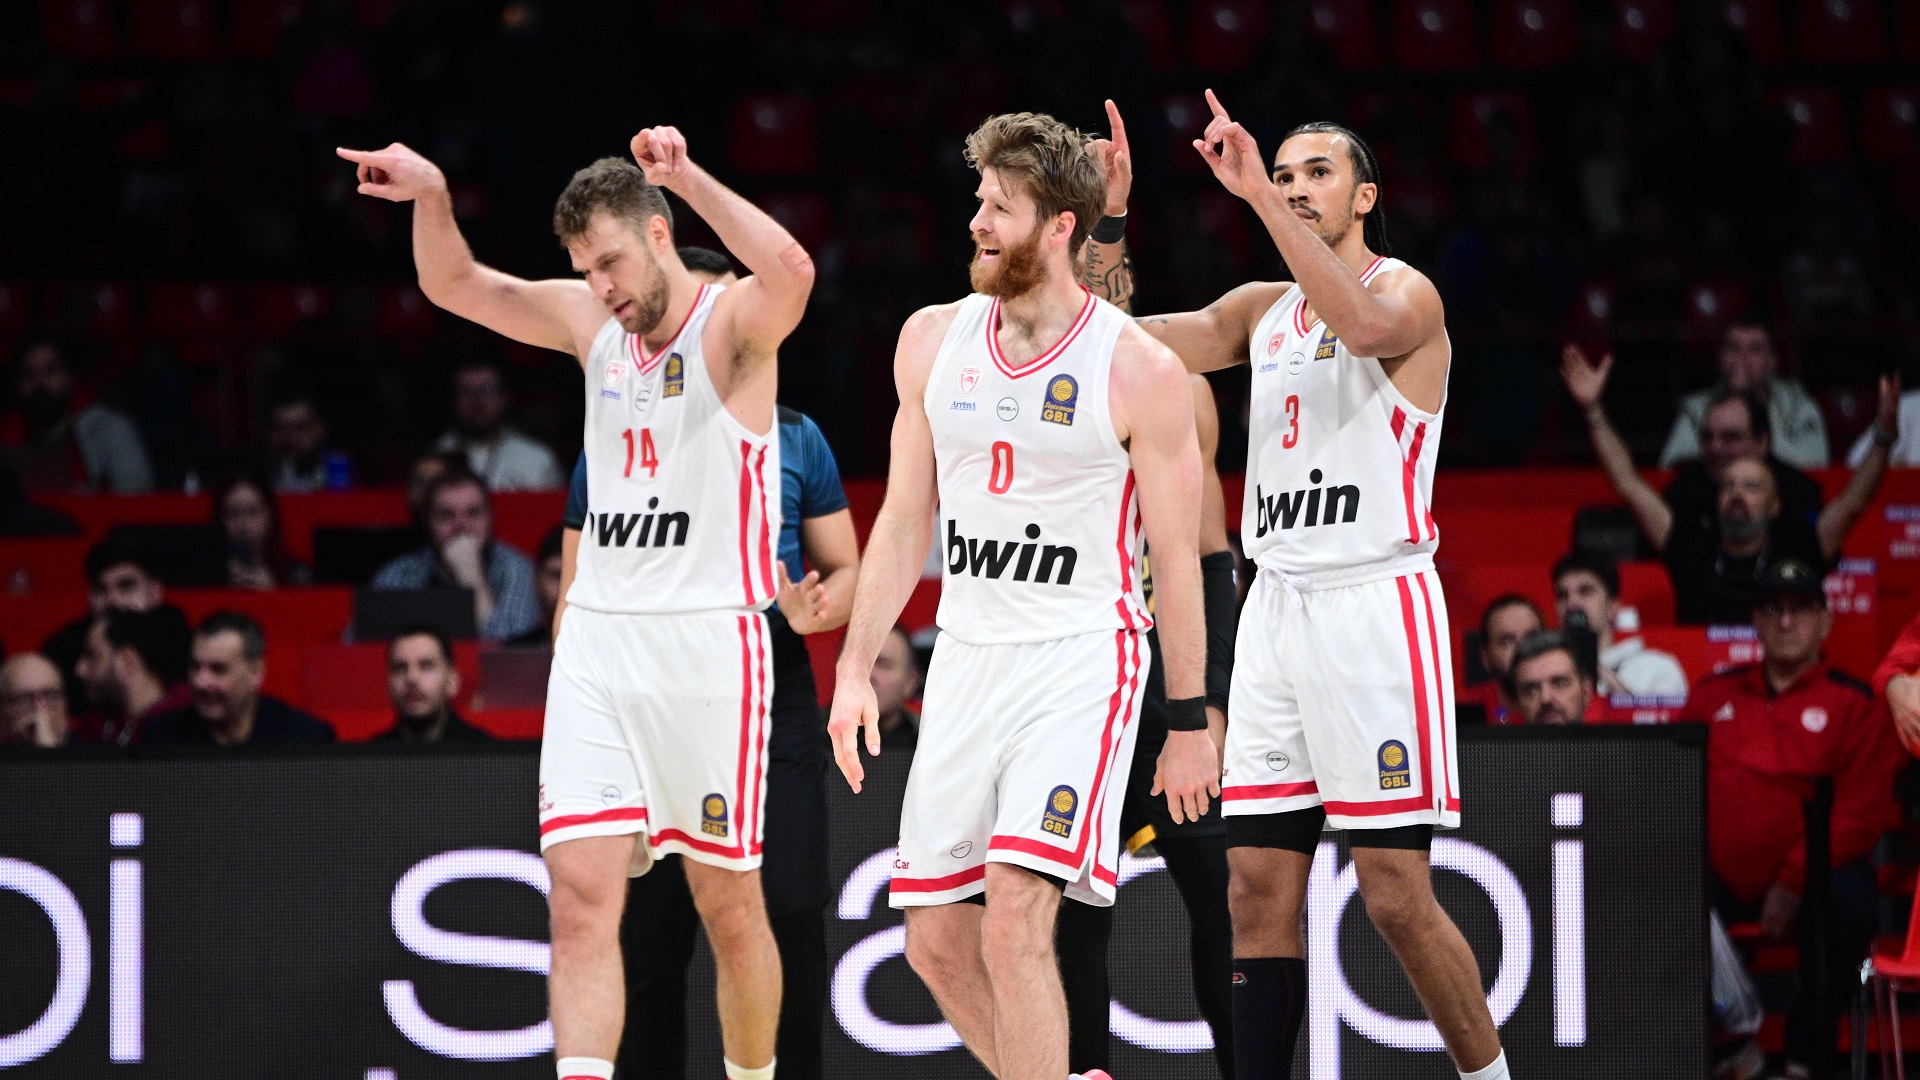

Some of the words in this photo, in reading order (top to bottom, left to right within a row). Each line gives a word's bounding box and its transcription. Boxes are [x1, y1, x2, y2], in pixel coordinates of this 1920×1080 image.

[1315, 347, 1334, 359] GBL
[1043, 409, 1071, 424] GBL
[1282, 394, 1299, 450] 3
[621, 427, 659, 479] 14
[988, 440, 1014, 495] 0
[1255, 468, 1360, 539] bwin
[947, 519, 1078, 586] bwin
[1381, 776, 1409, 789] GBL
[1042, 819, 1069, 837] GBL
